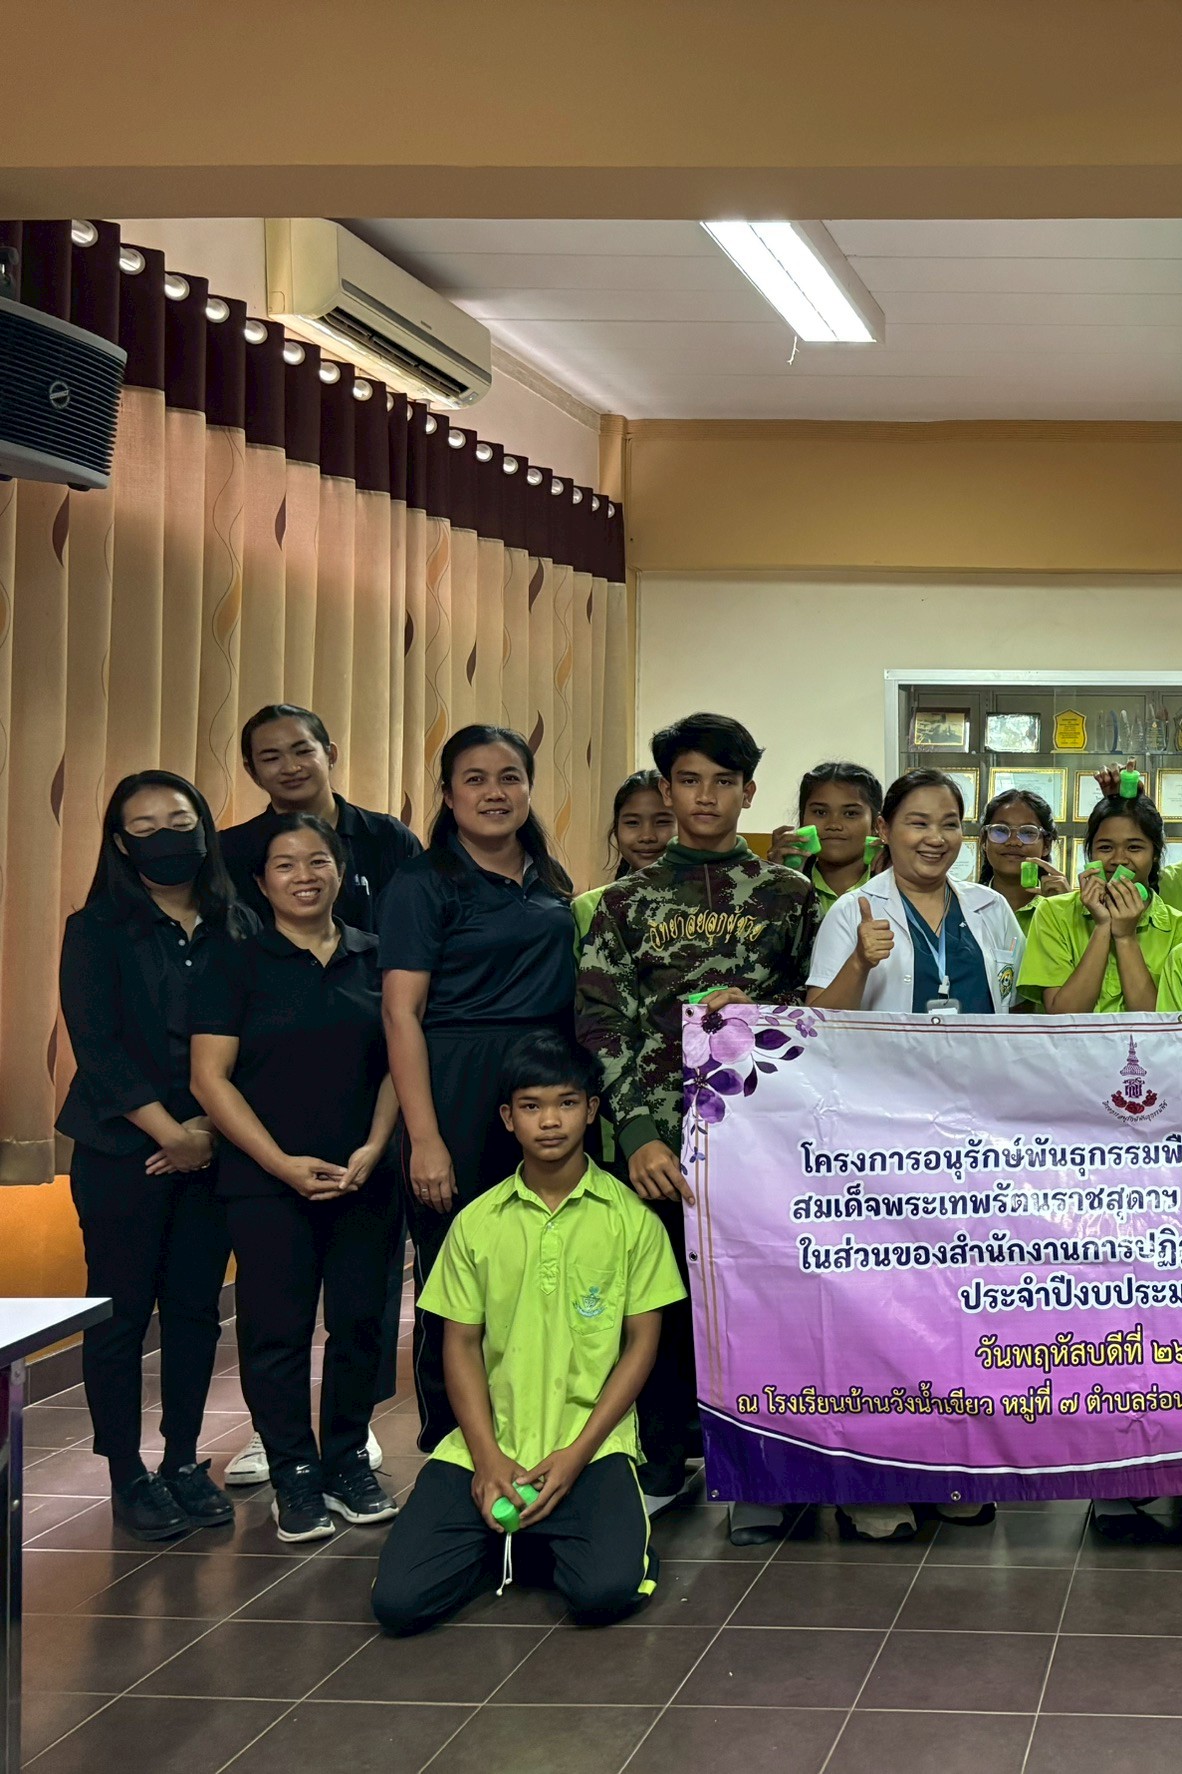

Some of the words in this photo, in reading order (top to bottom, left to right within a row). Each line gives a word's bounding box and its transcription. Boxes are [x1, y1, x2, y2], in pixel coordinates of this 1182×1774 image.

[793, 1182, 1177, 1220] สมเด็จพระเทพรัตนราชสุดาฯ
[976, 1324, 1142, 1372] วันพฤหัสบดีที่
[738, 1395, 758, 1413] ณ
[764, 1382, 993, 1415] โรงเรียนบ้านวังน้ำเขียว
[1002, 1380, 1051, 1422] หมู่ที่
[1060, 1393, 1079, 1413] ๗
